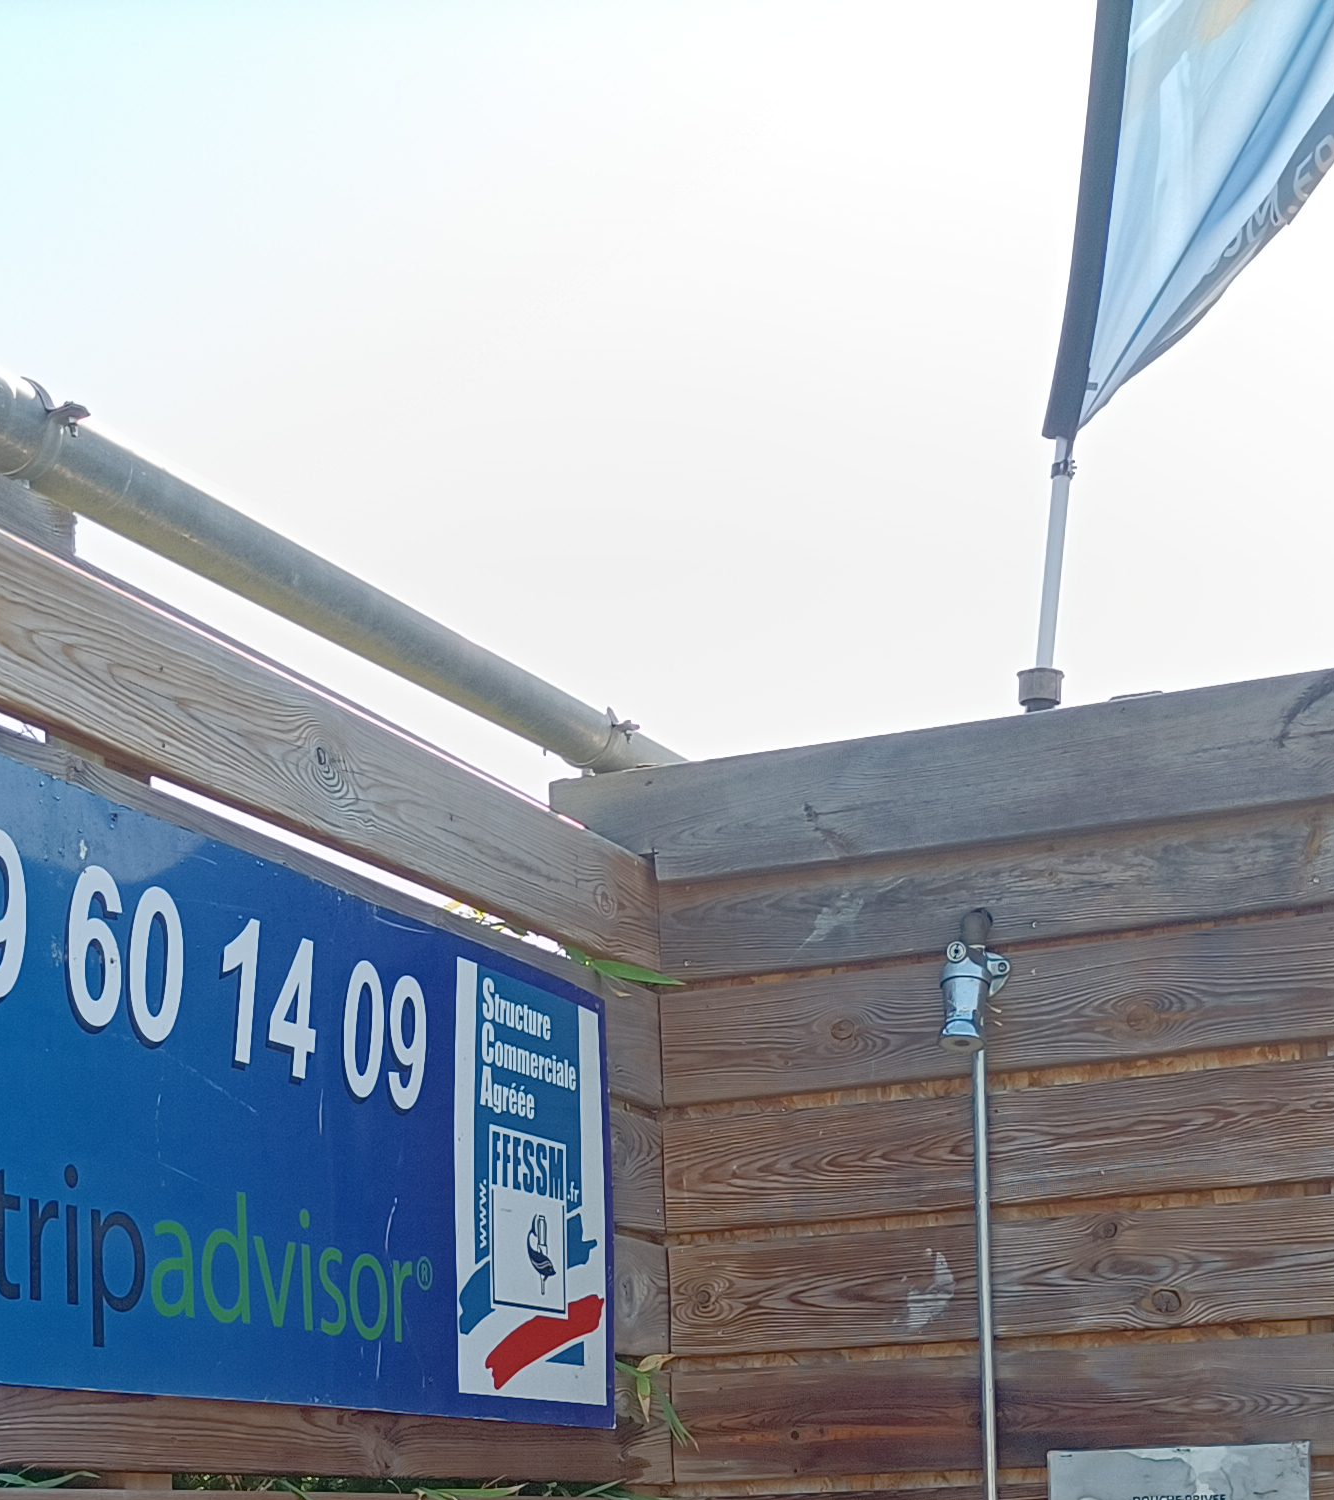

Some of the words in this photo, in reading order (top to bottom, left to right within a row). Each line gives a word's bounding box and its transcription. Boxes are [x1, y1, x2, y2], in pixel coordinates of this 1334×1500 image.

[67, 865, 184, 1047] 60
[221, 917, 316, 1081] 14
[342, 960, 427, 1111] 09
[482, 977, 552, 1041] Structure
[481, 1021, 577, 1091] Commerciale
[479, 1065, 535, 1120] Agréée
[492, 1131, 564, 1201] FFESSM
